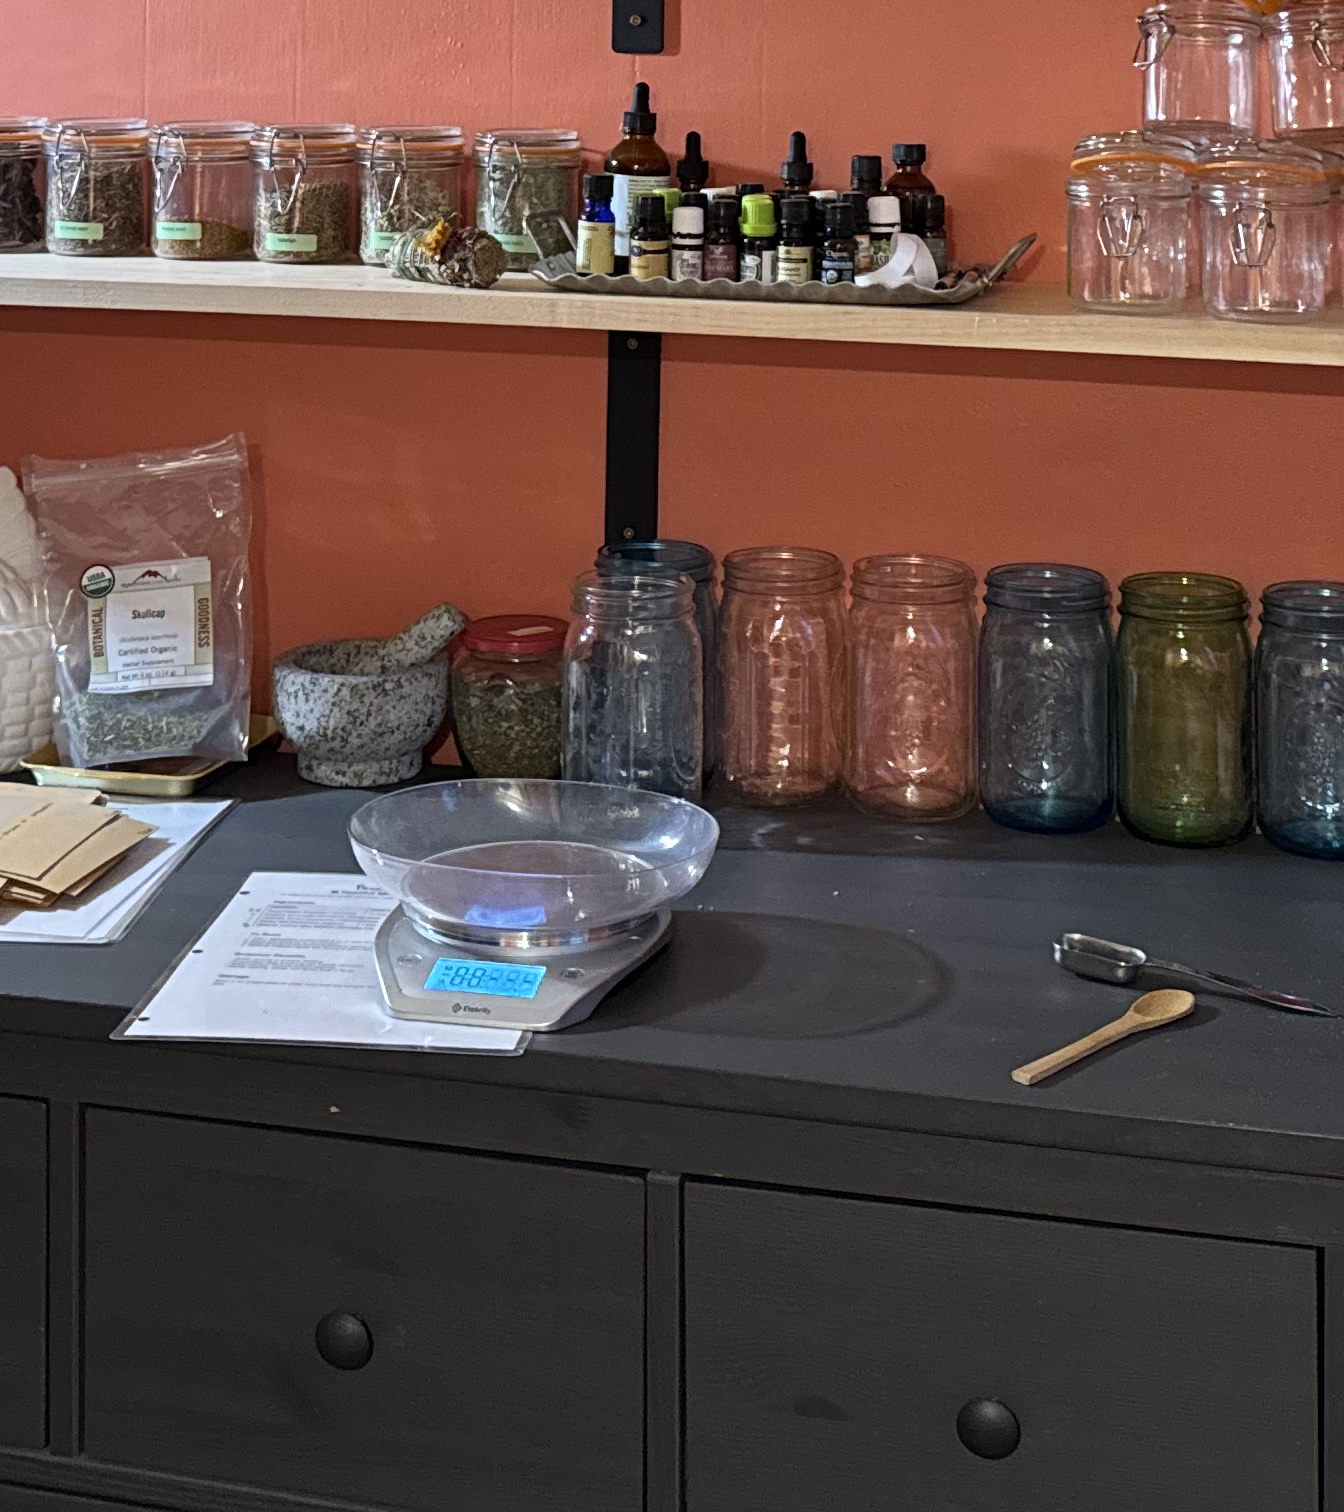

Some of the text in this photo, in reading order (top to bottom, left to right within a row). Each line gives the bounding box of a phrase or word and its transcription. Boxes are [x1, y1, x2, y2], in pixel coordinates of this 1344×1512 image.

[131, 609, 166, 620] Skullcap
[197, 597, 211, 649] GOODNESS
[91, 607, 105, 658] BOTANICAL
[118, 644, 178, 657] Certified Organic
